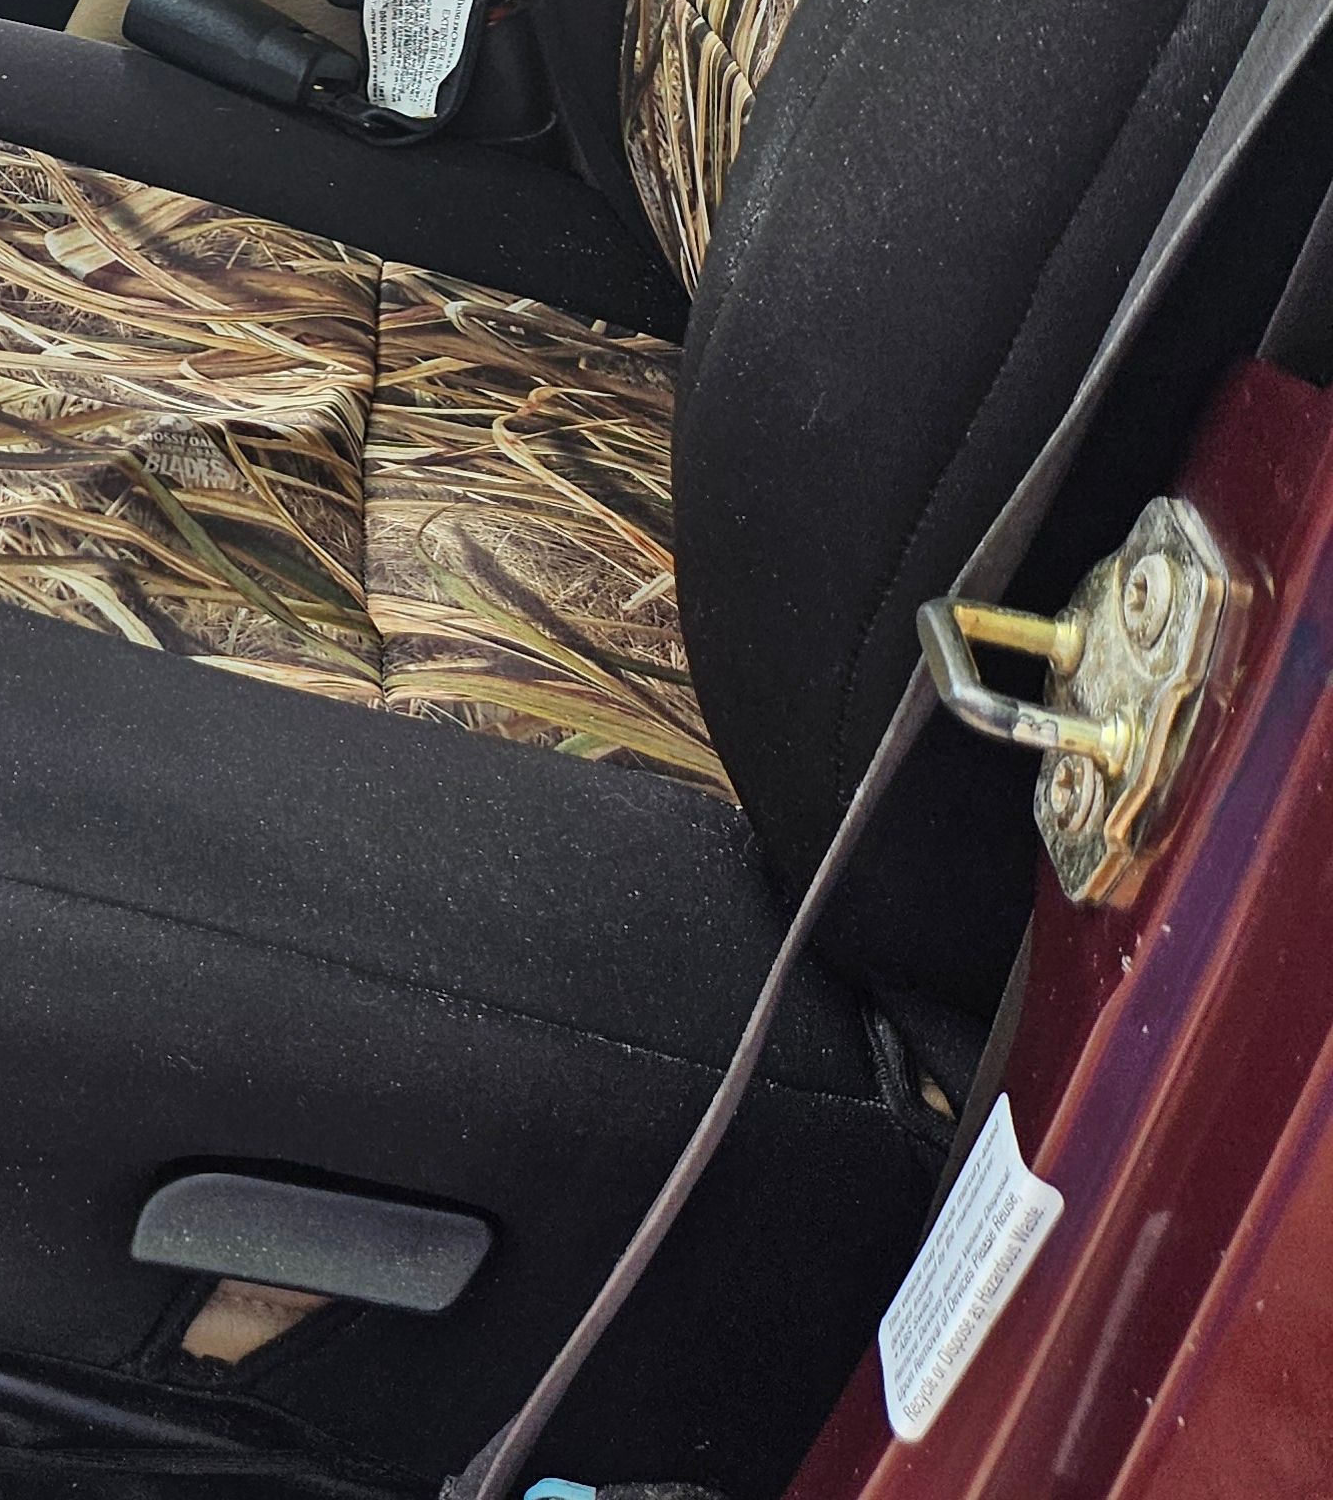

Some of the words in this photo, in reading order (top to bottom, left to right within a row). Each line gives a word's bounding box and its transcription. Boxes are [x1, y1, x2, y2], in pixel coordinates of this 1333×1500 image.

[425, 29, 440, 83] ASSEMBLY
[439, 9, 451, 62] EXTENDER
[1010, 1205, 1046, 1243] Waste.
[897, 1370, 916, 1402] Upon
[914, 1322, 942, 1373] Removal
[942, 1309, 950, 1327] of
[948, 1268, 976, 1313] Devices
[972, 1228, 997, 1269] Please
[996, 1190, 1023, 1232] Reuse,
[974, 1243, 1022, 1305] Hazardous
[970, 1302, 985, 1320] as
[937, 1316, 976, 1364] Dispose
[934, 1359, 946, 1380] or
[902, 1376, 938, 1422] Recycle
